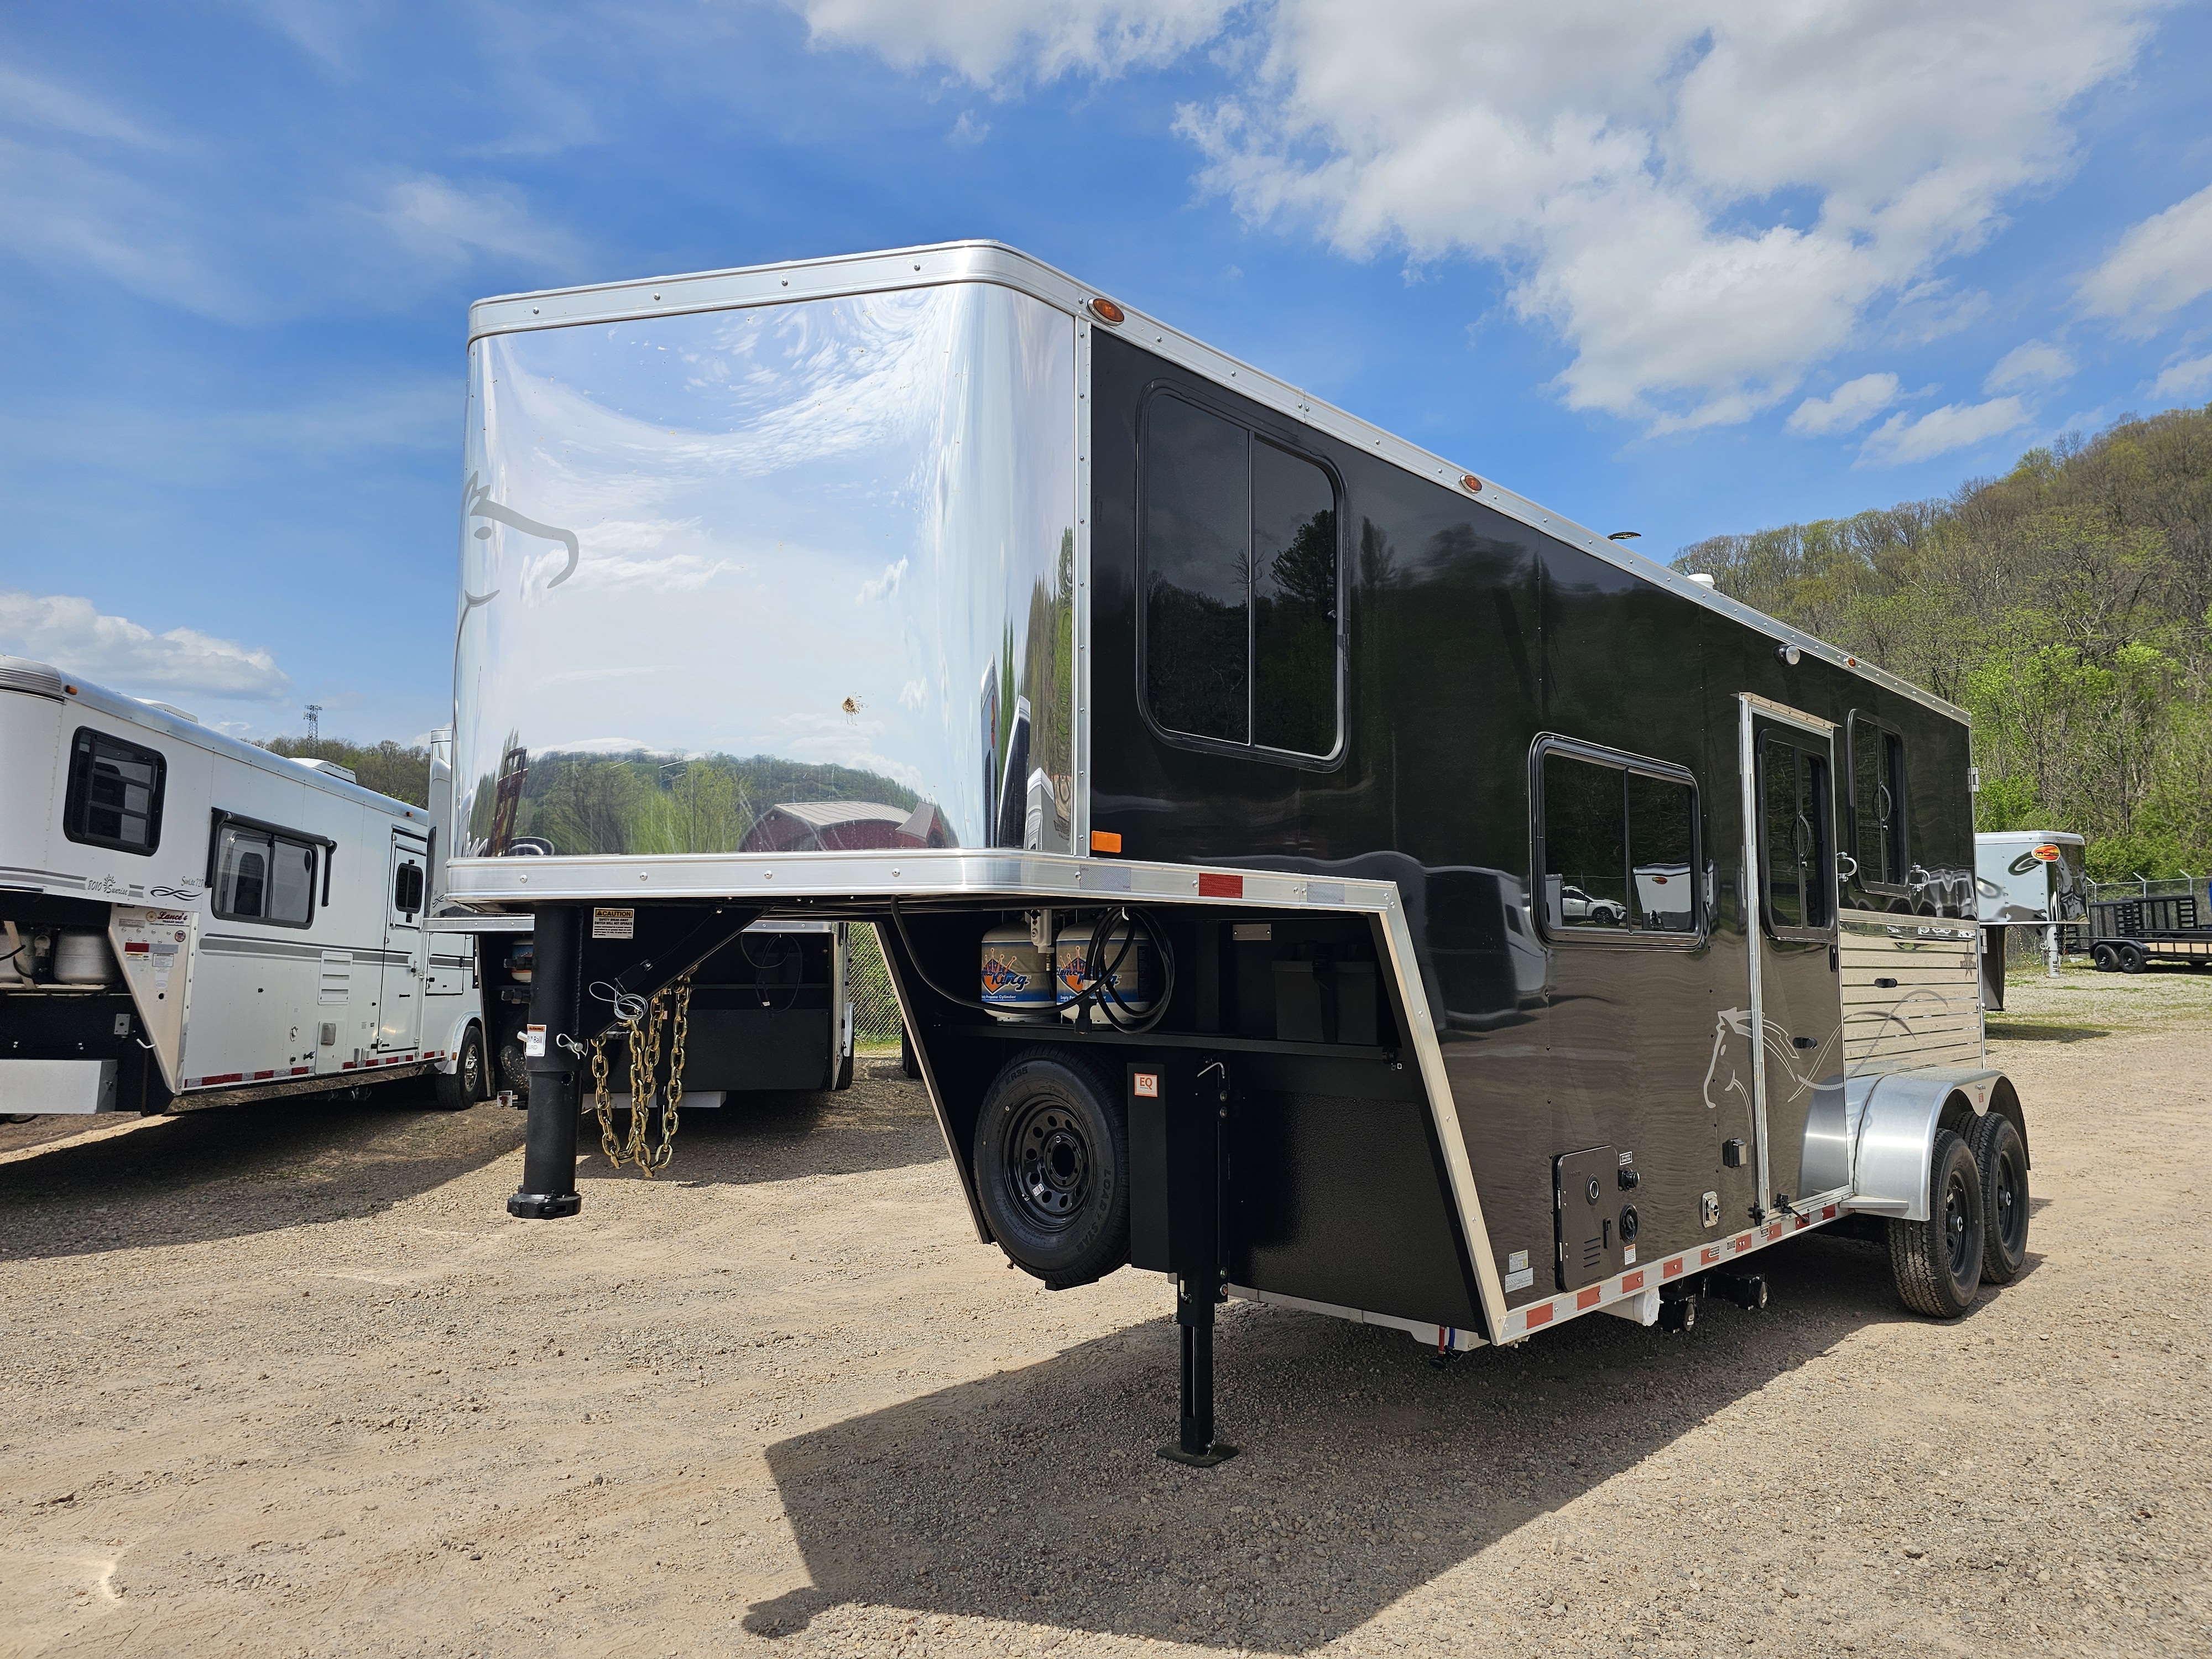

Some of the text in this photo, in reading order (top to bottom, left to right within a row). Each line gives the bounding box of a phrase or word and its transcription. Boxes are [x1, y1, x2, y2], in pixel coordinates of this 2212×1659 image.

[87, 880, 102, 891] 8010
[106, 884, 128, 895] Sunrise
[991, 971, 1029, 990] King
[1140, 1077, 1153, 1090] EQ
[1076, 1168, 1112, 1253] LOAD STAR
